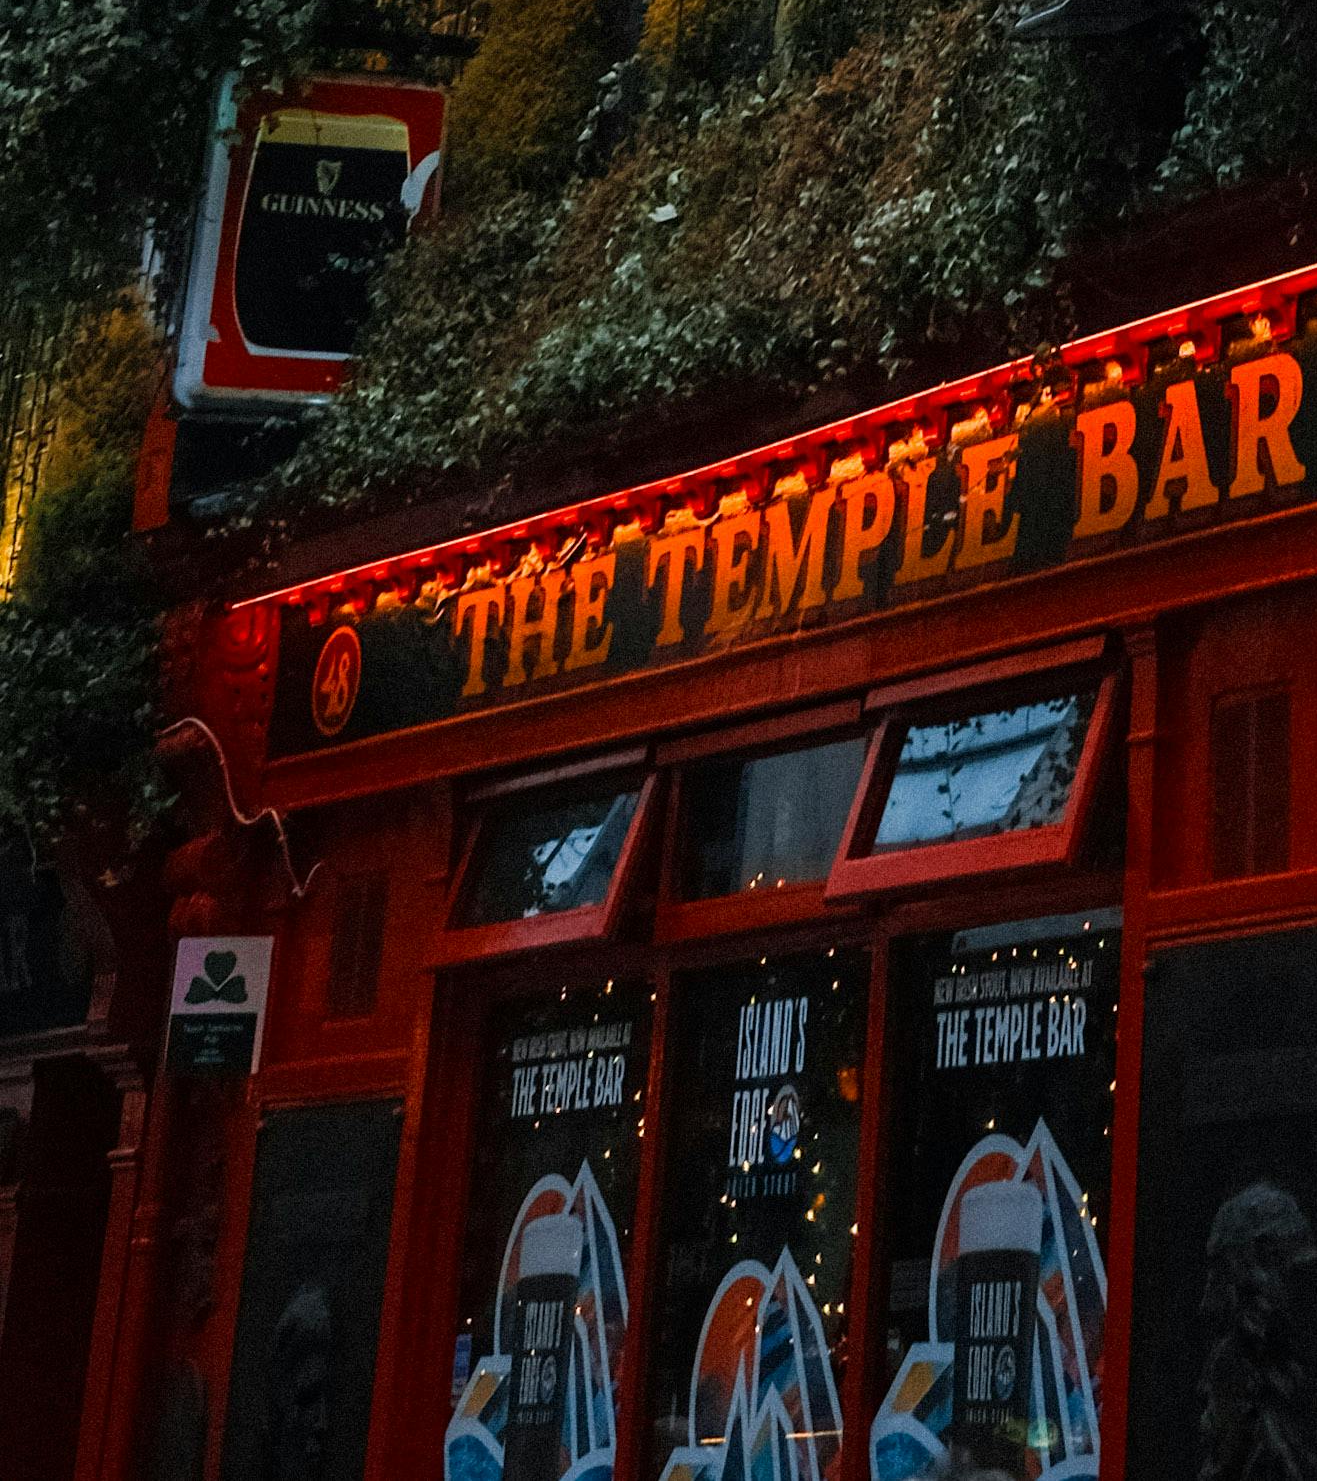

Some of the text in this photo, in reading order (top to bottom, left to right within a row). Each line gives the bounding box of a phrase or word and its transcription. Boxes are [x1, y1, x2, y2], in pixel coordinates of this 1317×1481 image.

[260, 192, 386, 223] GUINNESS
[456, 353, 1306, 697] THE TEMPLE BAR
[319, 651, 351, 718] 48
[735, 995, 809, 1081] ISLAND'S
[935, 996, 1088, 1071] THE TEMPLE BAR
[510, 1053, 626, 1120] THE TEMPLE BAR
[728, 1087, 770, 1168] EDGE
